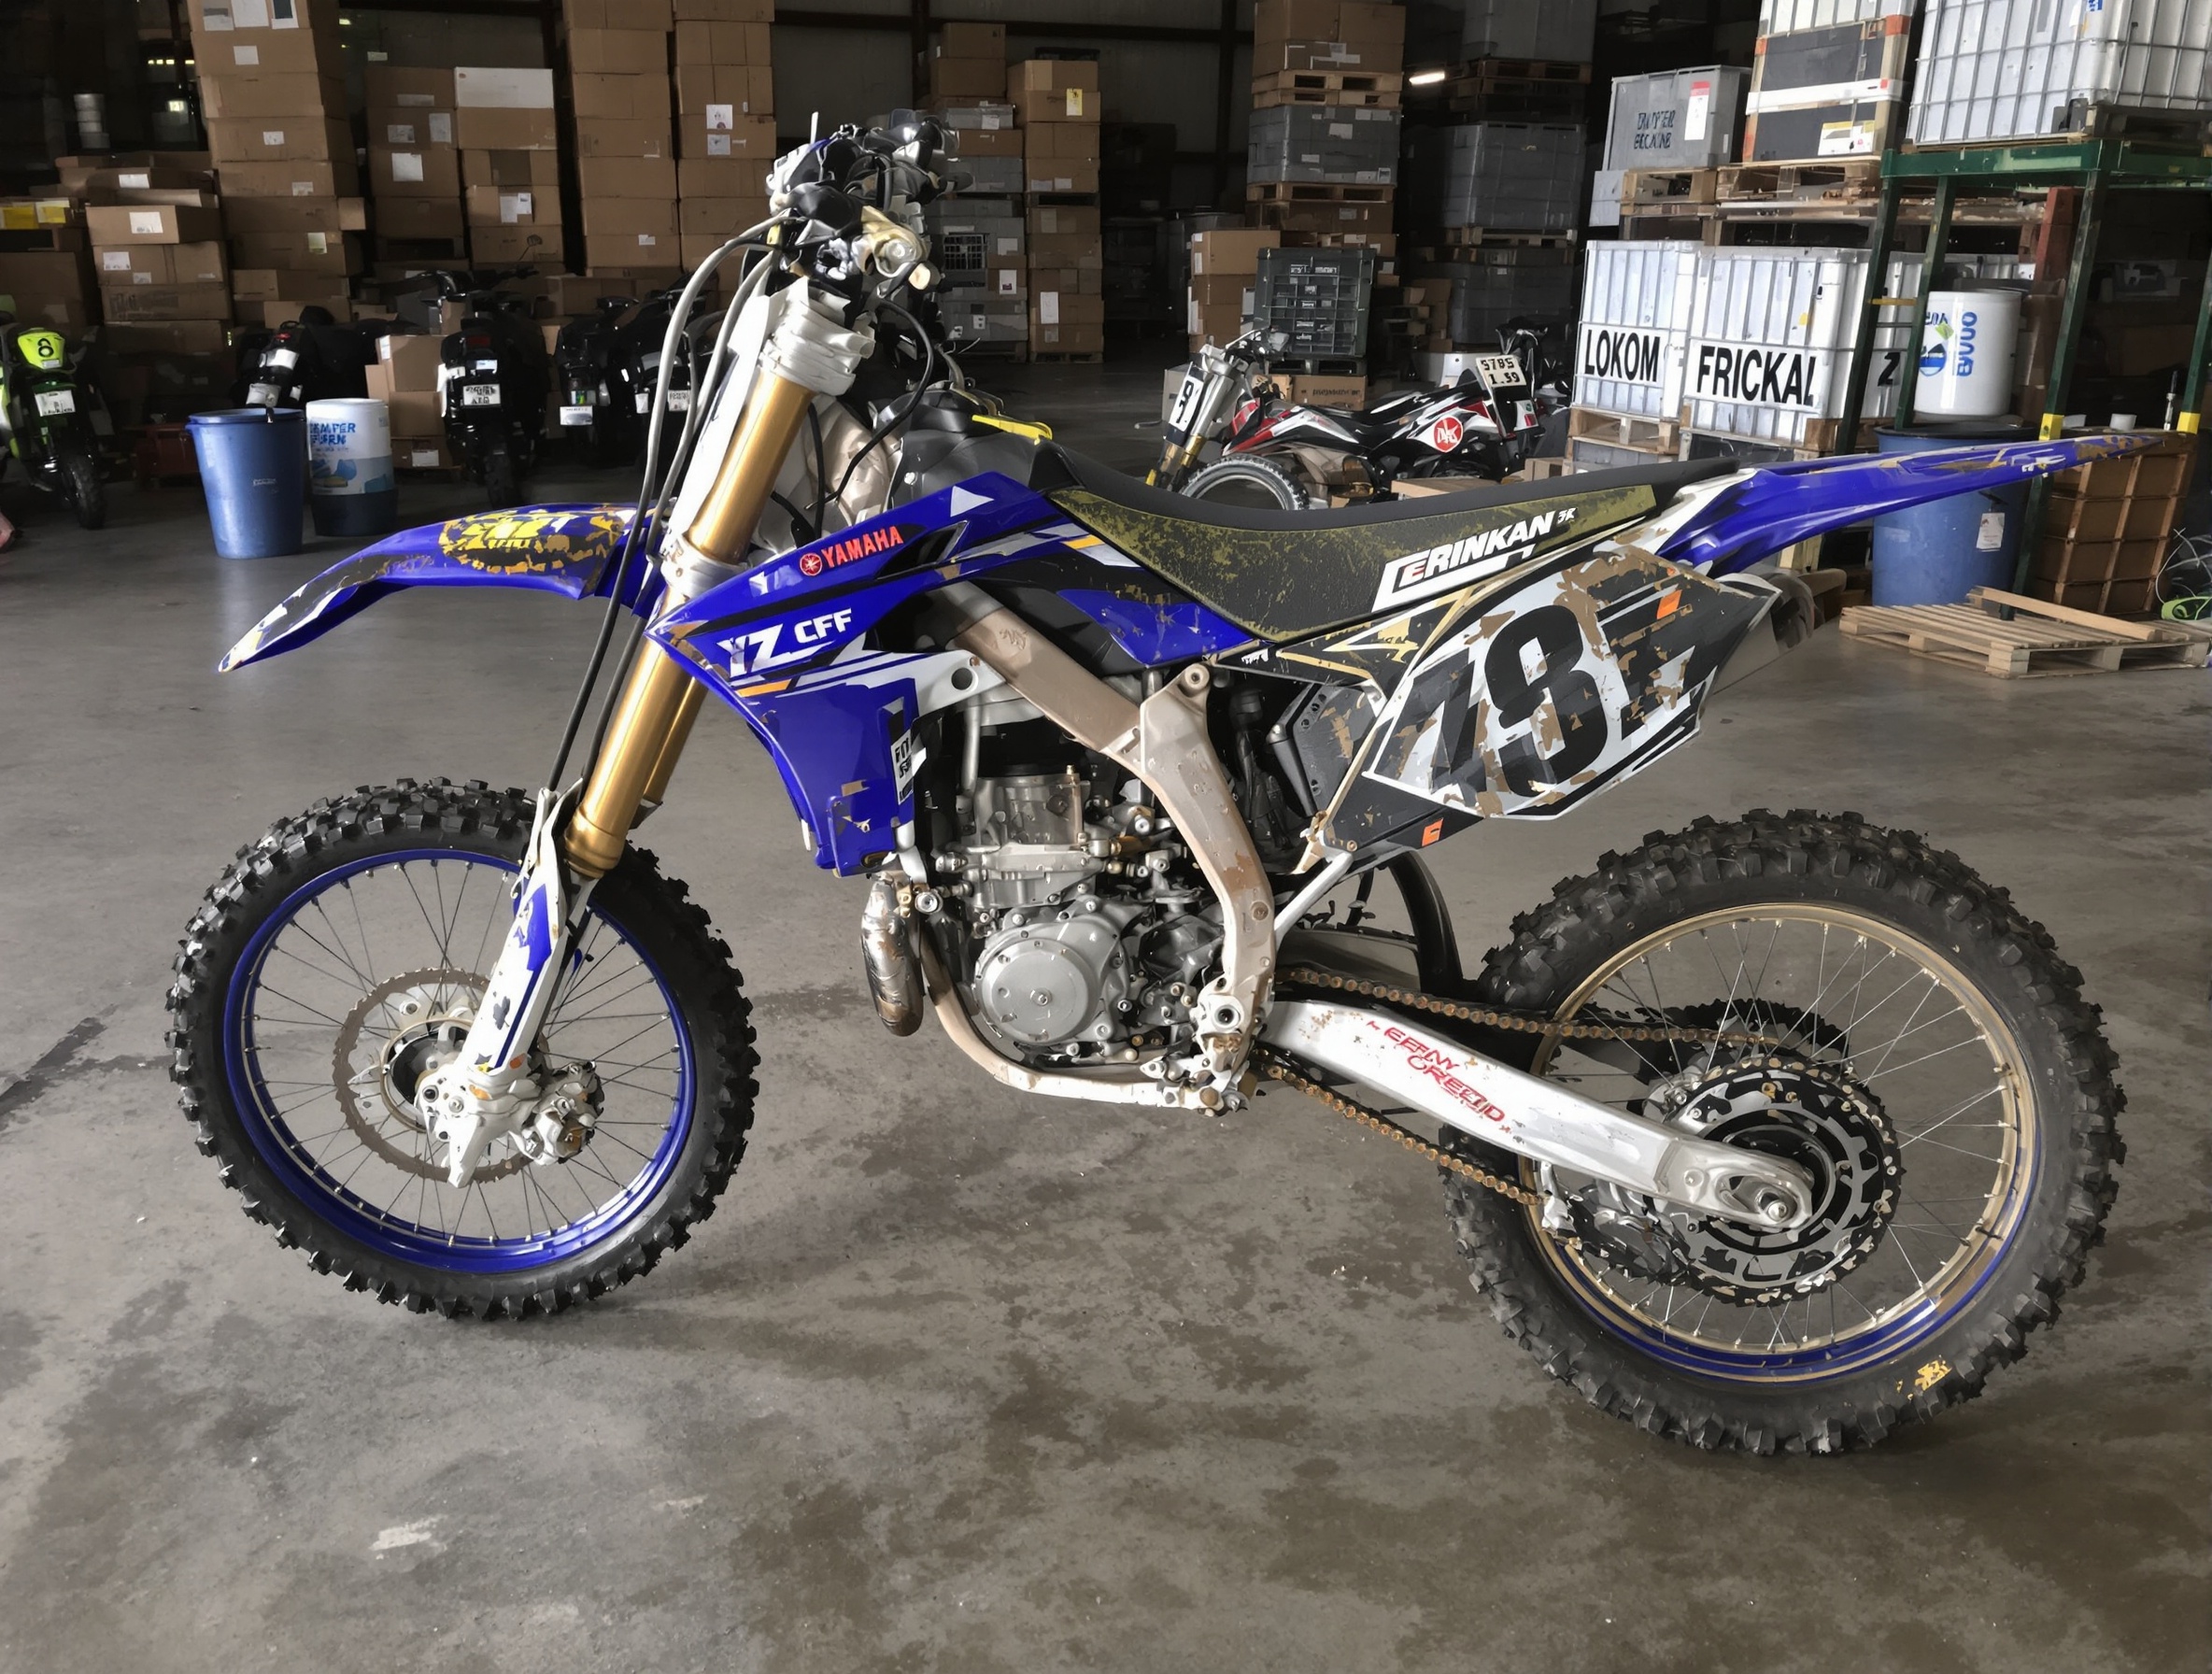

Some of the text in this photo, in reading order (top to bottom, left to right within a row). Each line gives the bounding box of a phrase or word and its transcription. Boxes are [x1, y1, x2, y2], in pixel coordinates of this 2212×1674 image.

[1584, 329, 1661, 382] LOKOM
[1696, 345, 1817, 407] FRICKAL
[821, 526, 904, 569] YAMAHA
[794, 608, 852, 645] CFF
